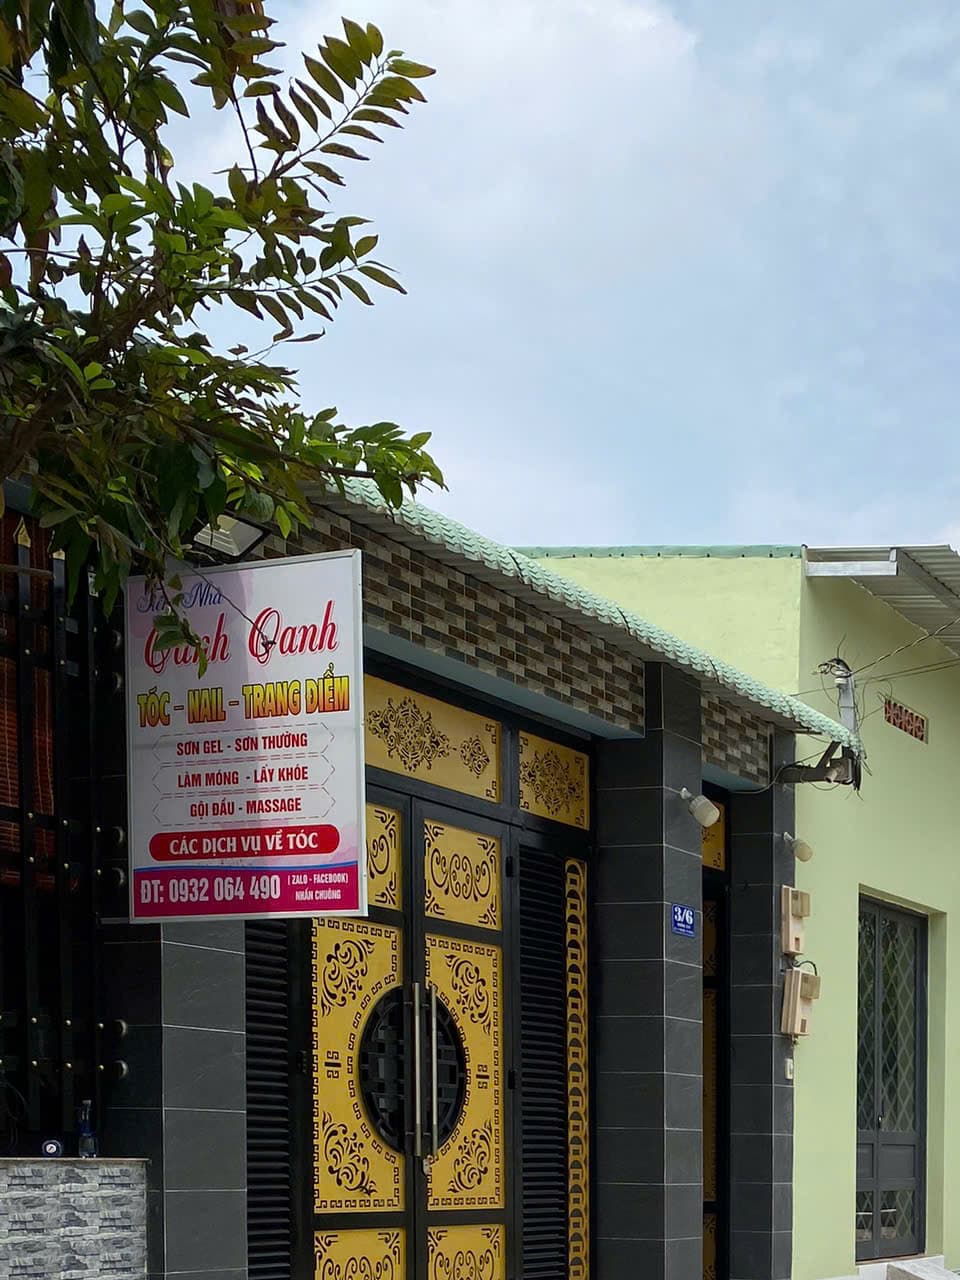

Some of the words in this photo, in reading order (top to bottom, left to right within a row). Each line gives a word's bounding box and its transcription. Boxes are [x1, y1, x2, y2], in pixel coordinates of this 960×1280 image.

[249, 600, 338, 664] Oanh
[137, 686, 170, 727] TÓC
[188, 687, 226, 723] NAIL
[242, 680, 301, 719] TRANG
[305, 662, 349, 714] ĐIỂM
[177, 741, 200, 756] SƠN
[203, 740, 223, 754] GEL
[235, 736, 258, 752] SƠN
[262, 731, 308, 749] THƯỜNG
[178, 771, 201, 788] LÀM
[205, 769, 239, 786] MÓNG
[190, 801, 208, 819] GỘI
[246, 798, 302, 814] MASSAGE
[169, 836, 198, 855] CÁC
[202, 836, 237, 856] DỊCH
[241, 835, 261, 855] VỤ
[265, 829, 283, 850] VỀ
[287, 829, 318, 849] TÓC
[140, 880, 164, 903] ĐT:
[168, 878, 209, 902] 0932
[214, 876, 244, 901] 064
[250, 875, 281, 899] 490
[674, 906, 693, 925] 3/6
